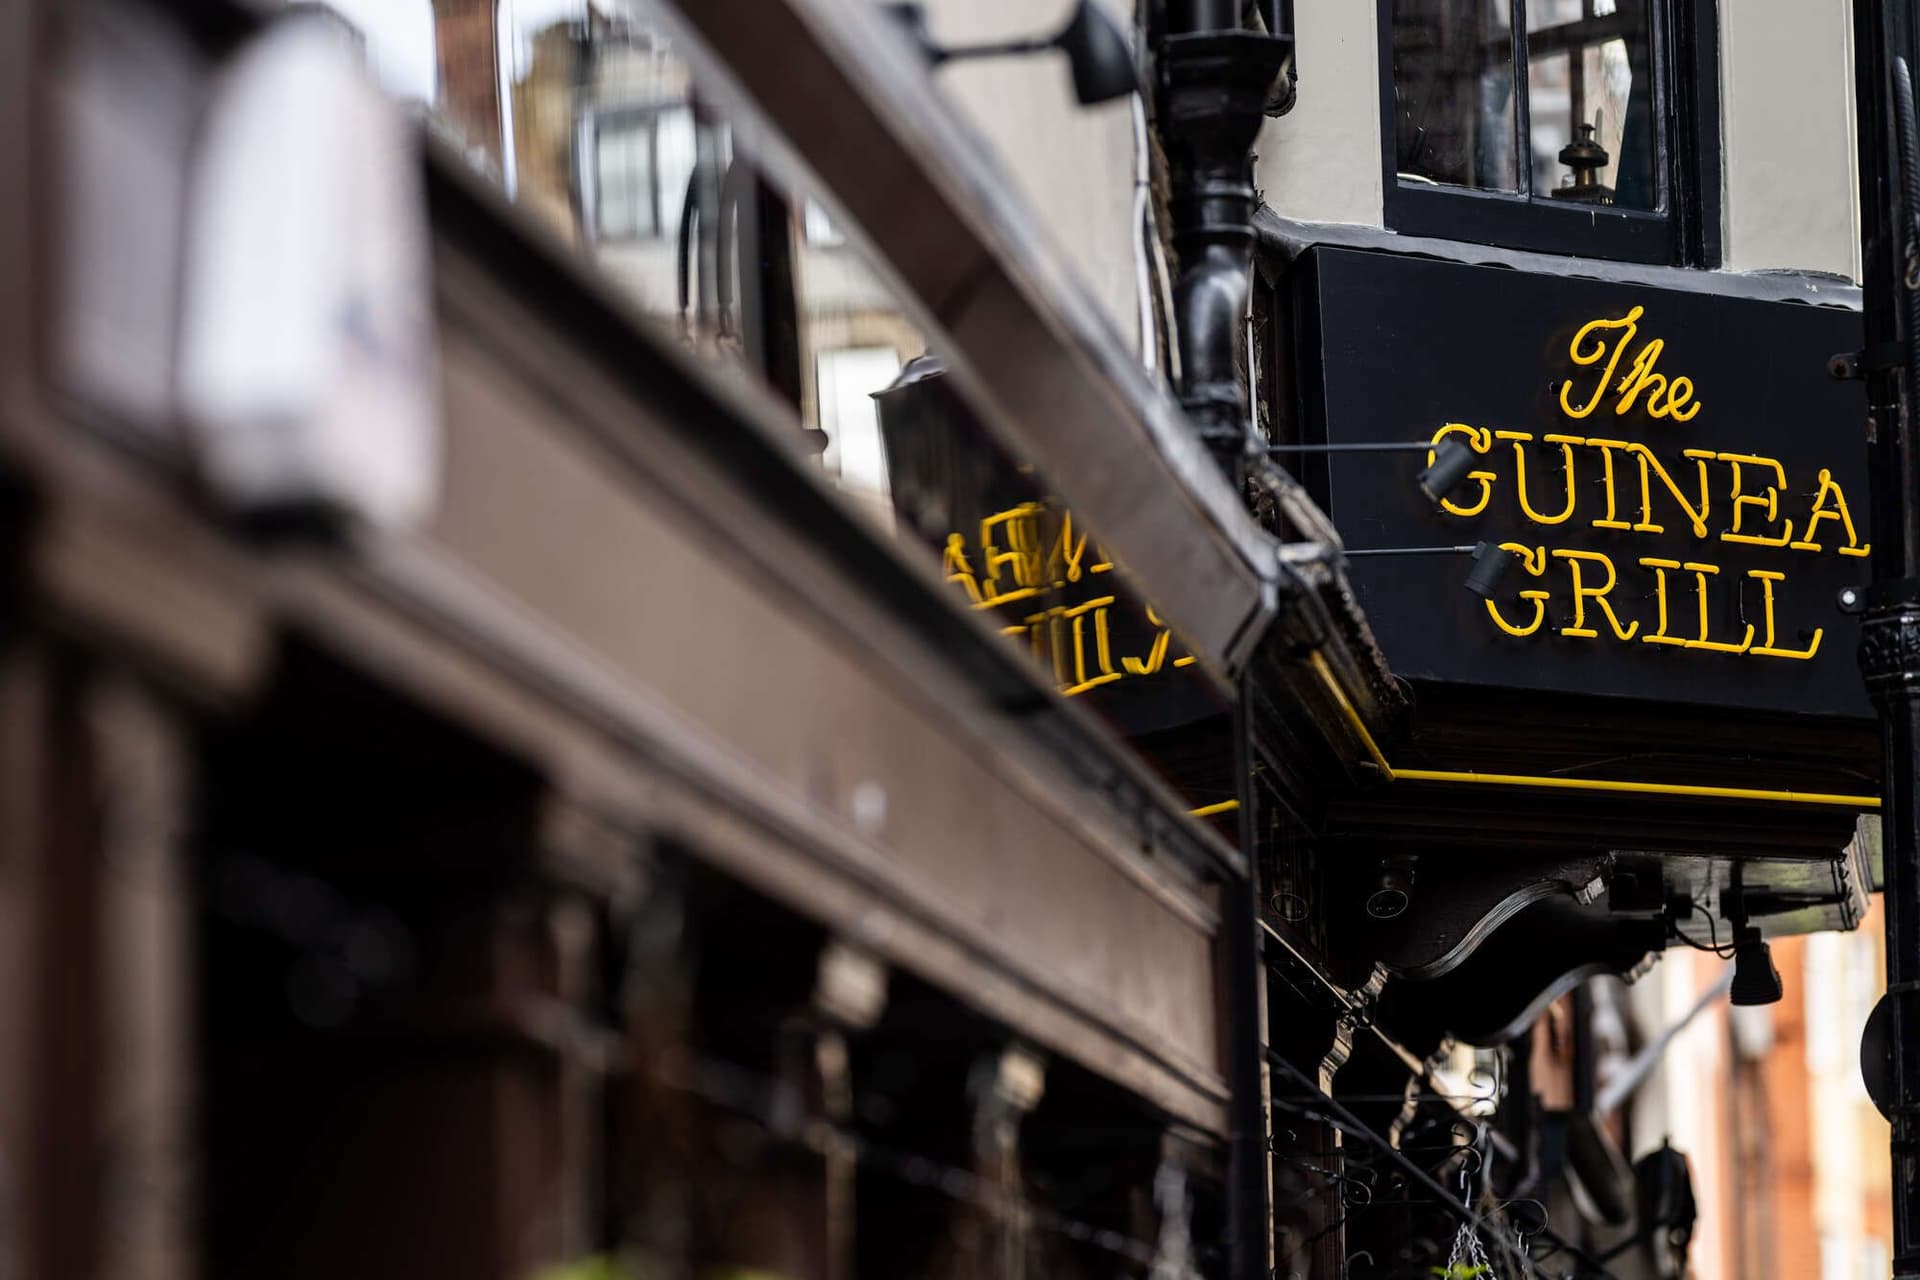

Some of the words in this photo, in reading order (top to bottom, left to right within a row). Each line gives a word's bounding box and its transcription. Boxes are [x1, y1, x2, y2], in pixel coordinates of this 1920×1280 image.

[1560, 306, 1701, 422] The
[1427, 423, 1871, 557] GUINEA
[1484, 542, 1823, 660] GRILL
